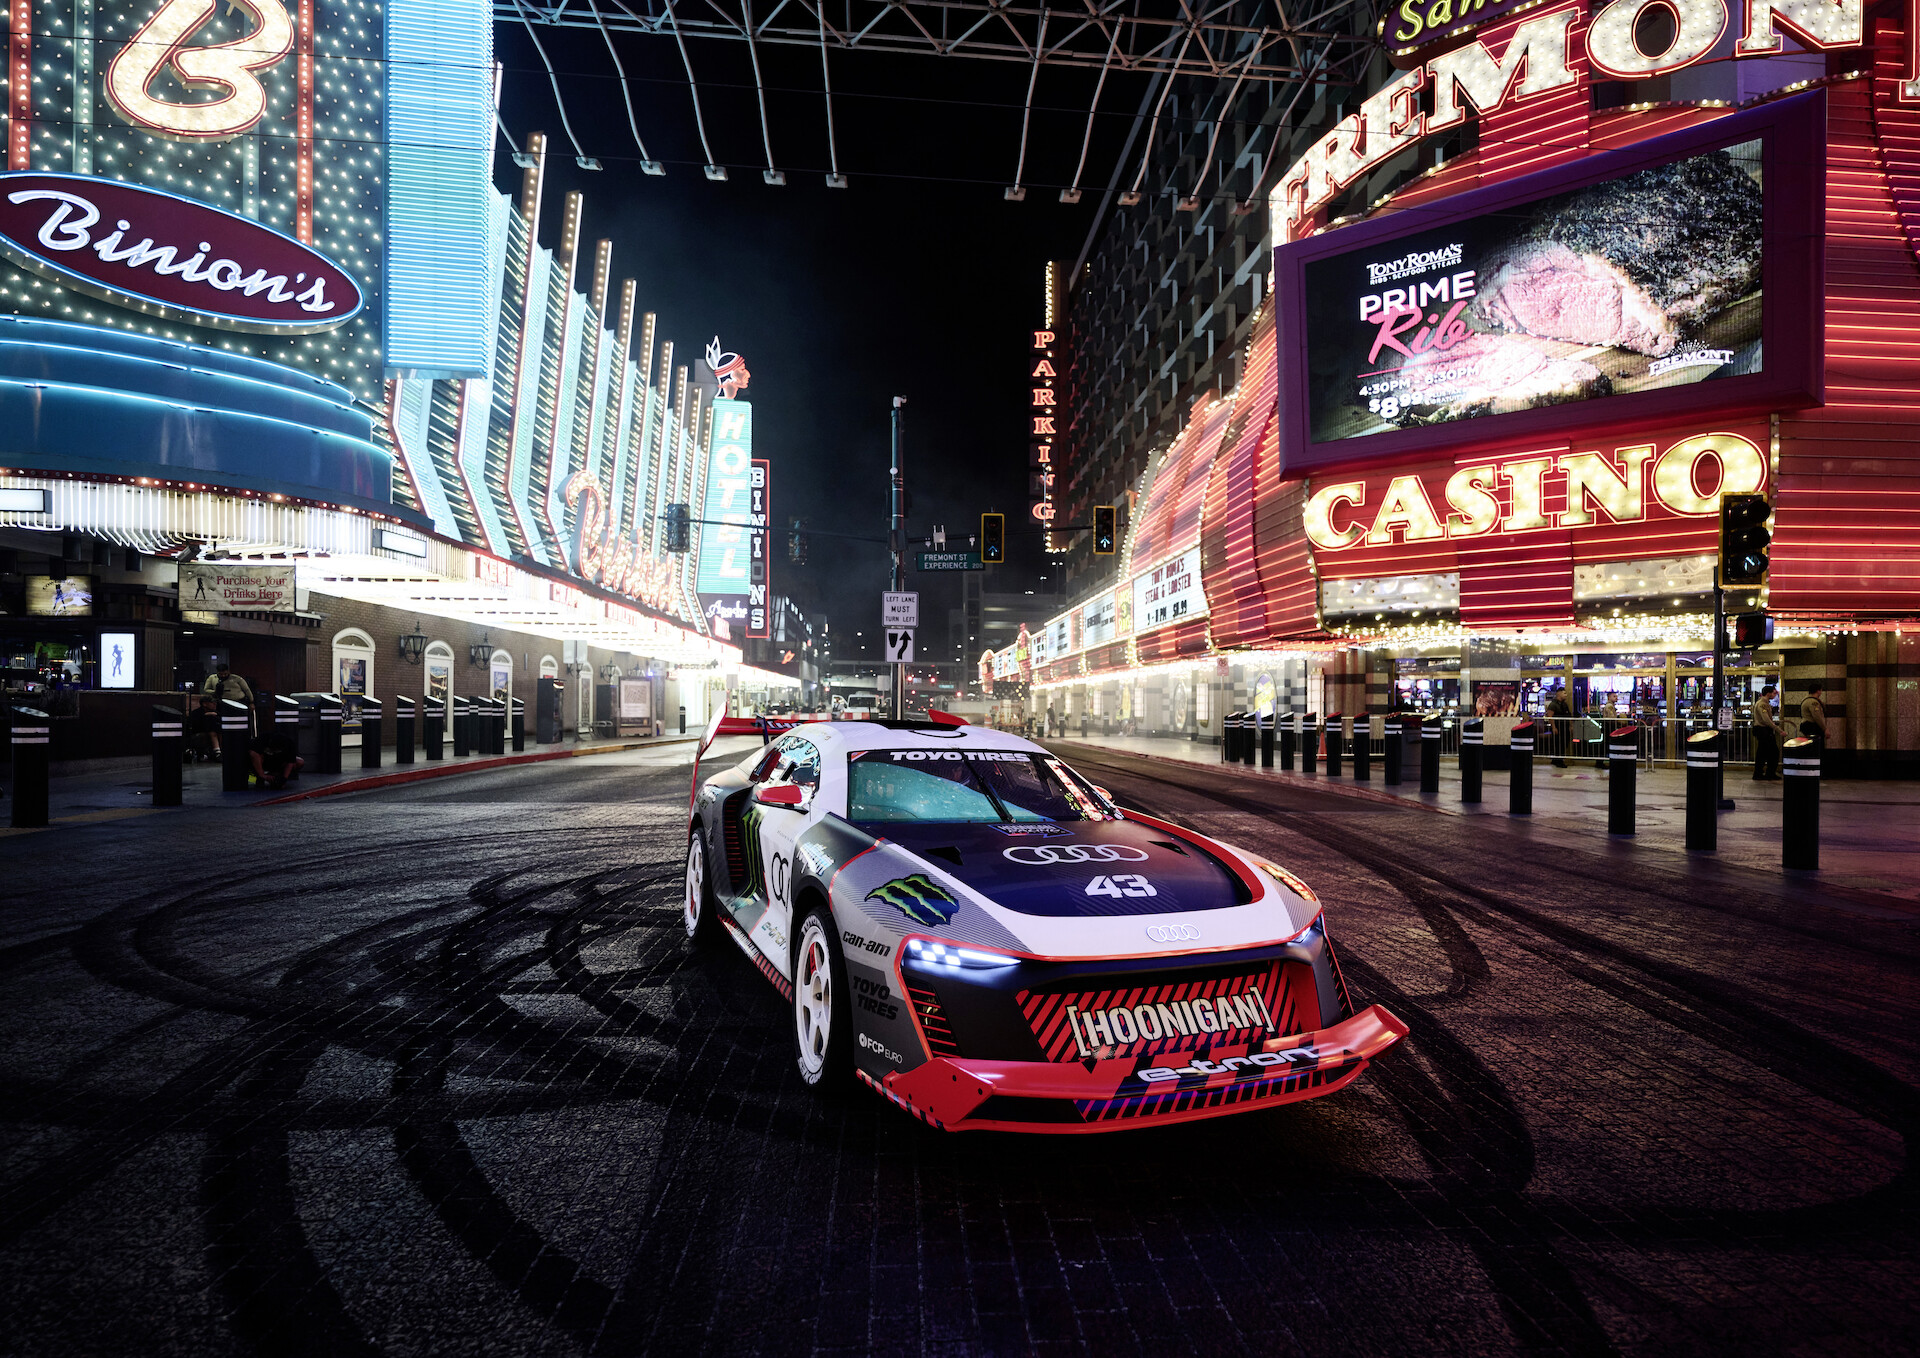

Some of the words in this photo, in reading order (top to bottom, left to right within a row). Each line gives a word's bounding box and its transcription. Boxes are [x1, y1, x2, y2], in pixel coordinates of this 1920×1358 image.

[1268, 0, 1920, 292] FREMON
[8, 189, 336, 313] Binion's
[1370, 276, 1388, 285] RIBS
[1431, 257, 1462, 272] STEAKS
[1359, 269, 1477, 322] PRIME
[1367, 300, 1475, 365] Rib
[1648, 349, 1734, 377] FREMONT
[1359, 378, 1411, 396] 4:30PM
[1424, 366, 1479, 385] 6:30PM
[1032, 330, 1056, 522] PARKING
[715, 411, 747, 579] HOTEL
[1303, 432, 1768, 551] CASINO
[751, 467, 766, 630] BINIONS
[216, 575, 262, 586] Purchase
[265, 575, 288, 586] Your
[223, 588, 257, 599] Drinks
[259, 588, 283, 600] Here
[1168, 572, 1191, 596] LOBSTER
[891, 605, 910, 613] MUST
[890, 751, 964, 762] TOYO
[964, 751, 1030, 763] TIRES
[1084, 874, 1158, 899] 43
[842, 930, 891, 958] can-am
[853, 975, 890, 1001] TOYO
[857, 993, 898, 1020] TIRES
[867, 1037, 885, 1055] FCP
[884, 1047, 904, 1065] EURO
[1137, 1047, 1320, 1083] e-tron
